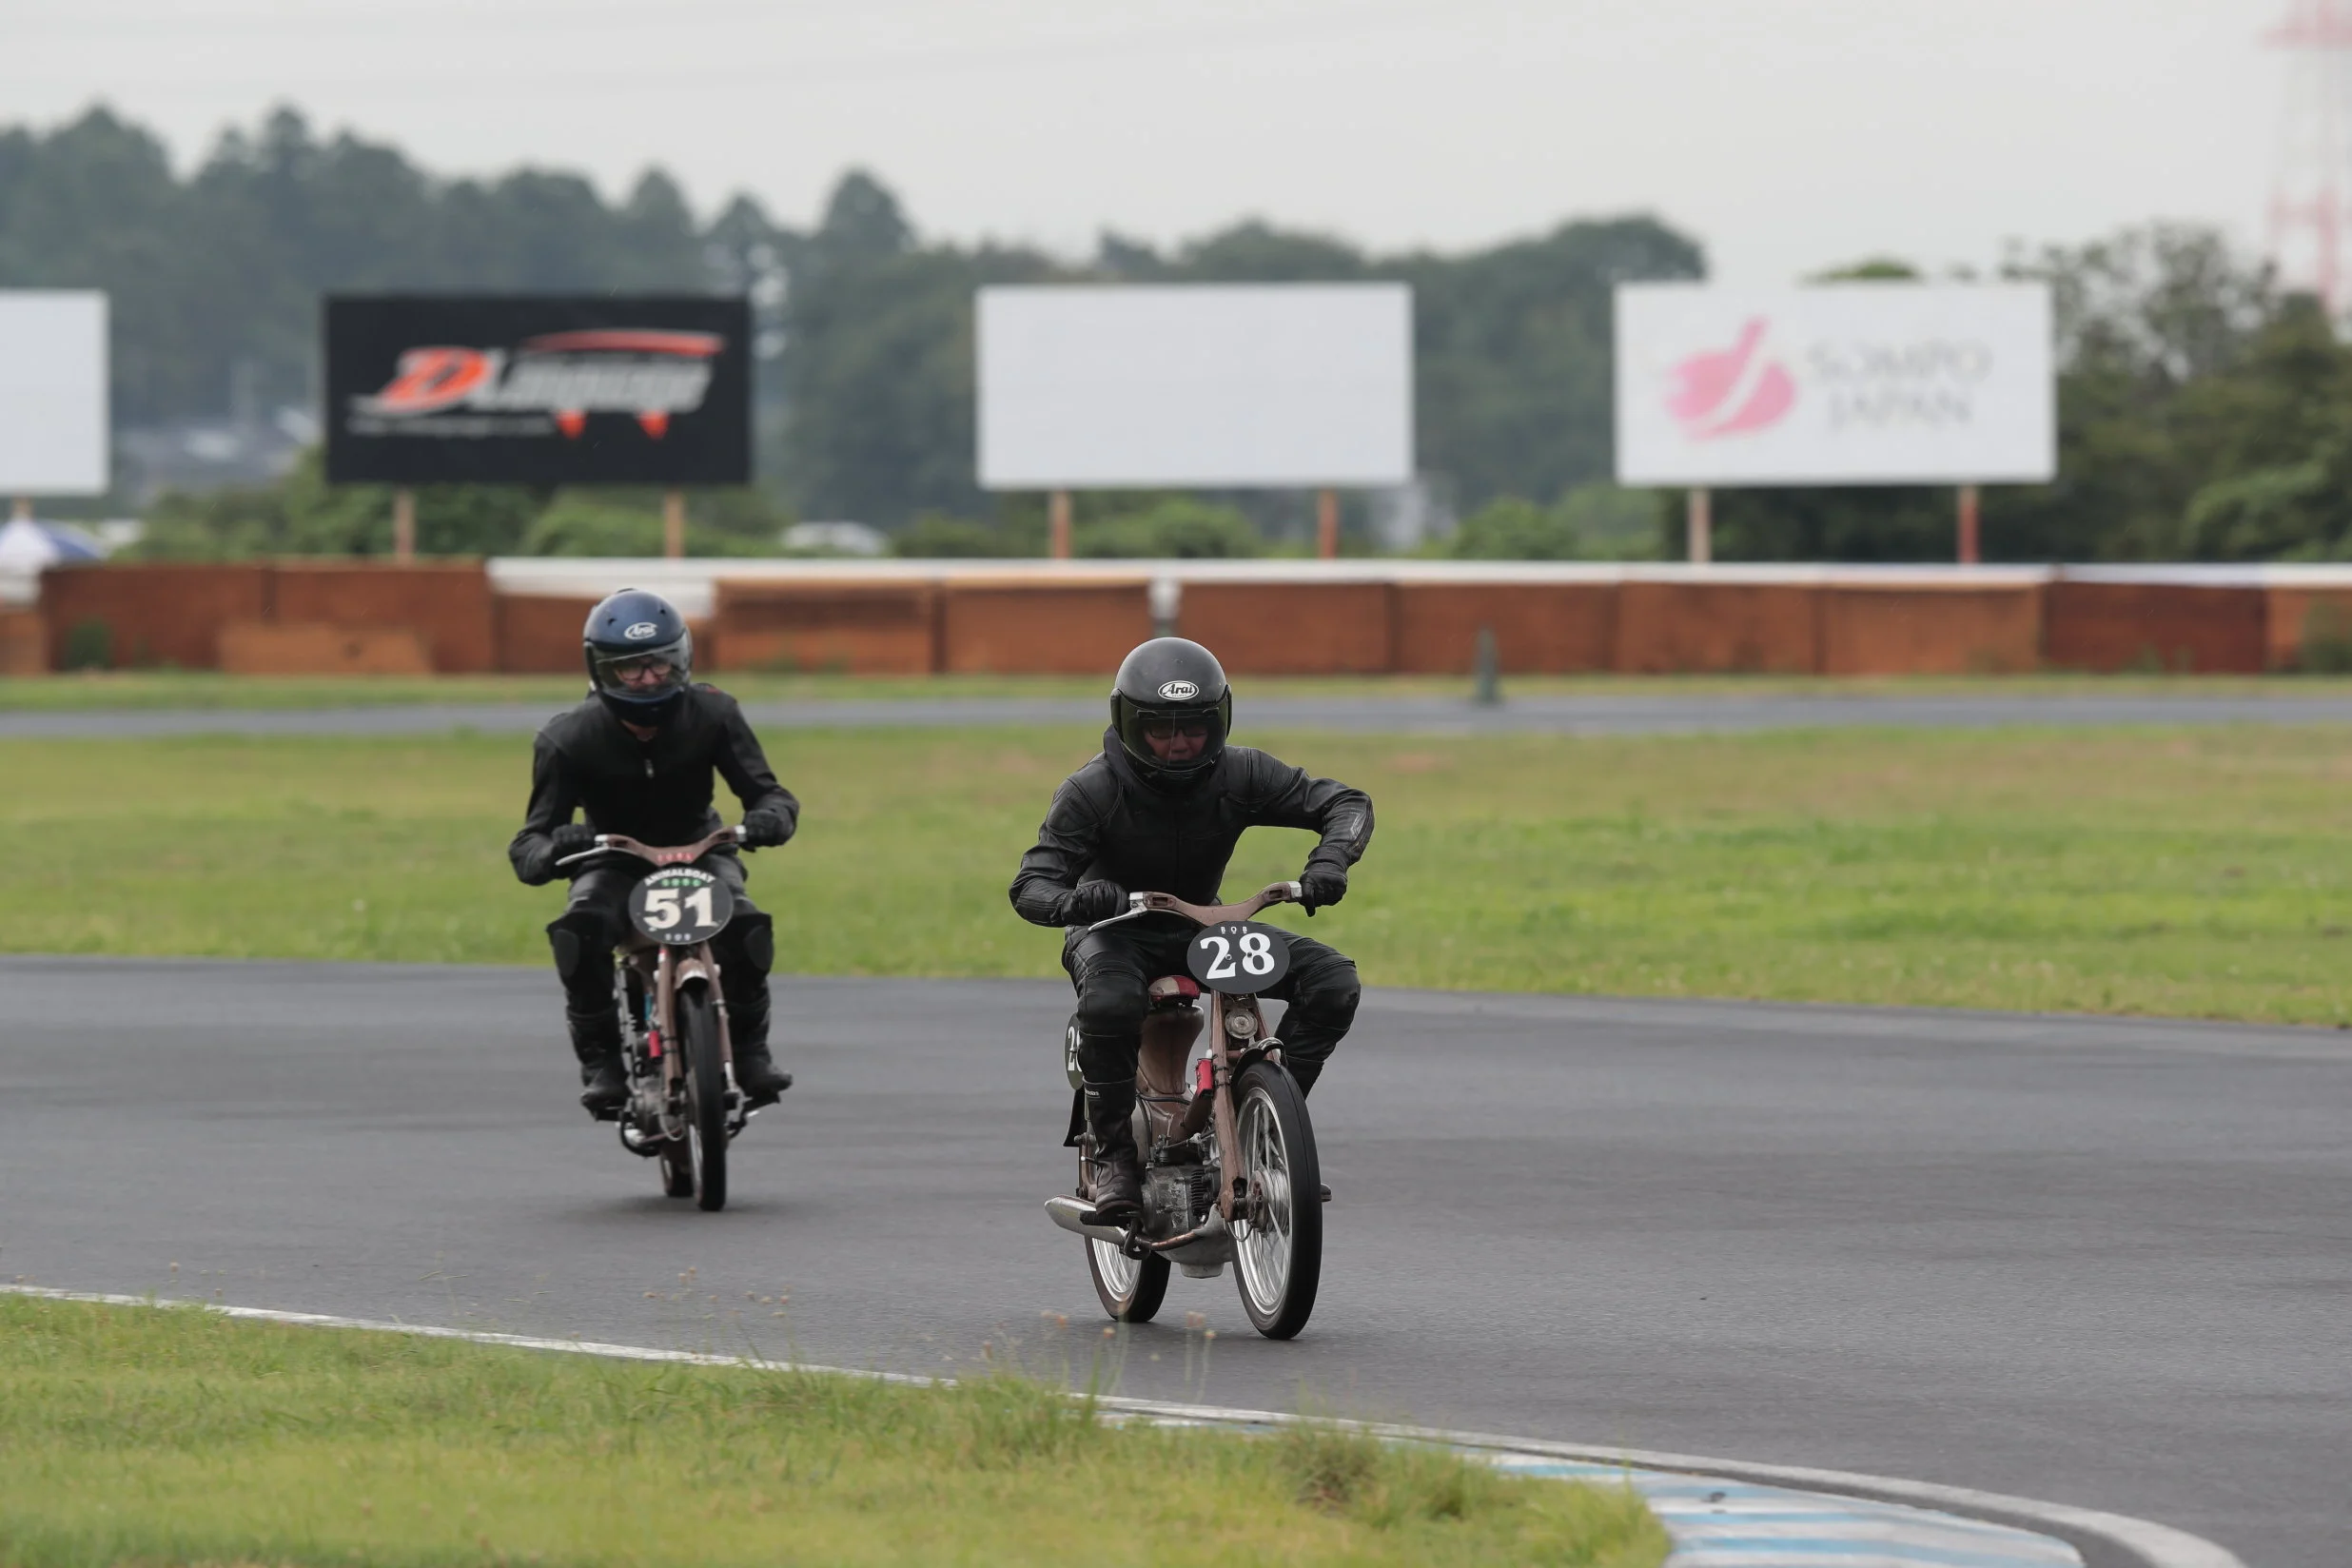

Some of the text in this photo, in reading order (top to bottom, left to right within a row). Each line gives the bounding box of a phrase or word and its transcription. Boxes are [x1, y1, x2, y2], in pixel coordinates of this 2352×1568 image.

[1161, 683, 1195, 695] Arai
[643, 887, 718, 929] 51
[1221, 926, 1248, 934] BOB
[1200, 932, 1275, 980] 28
